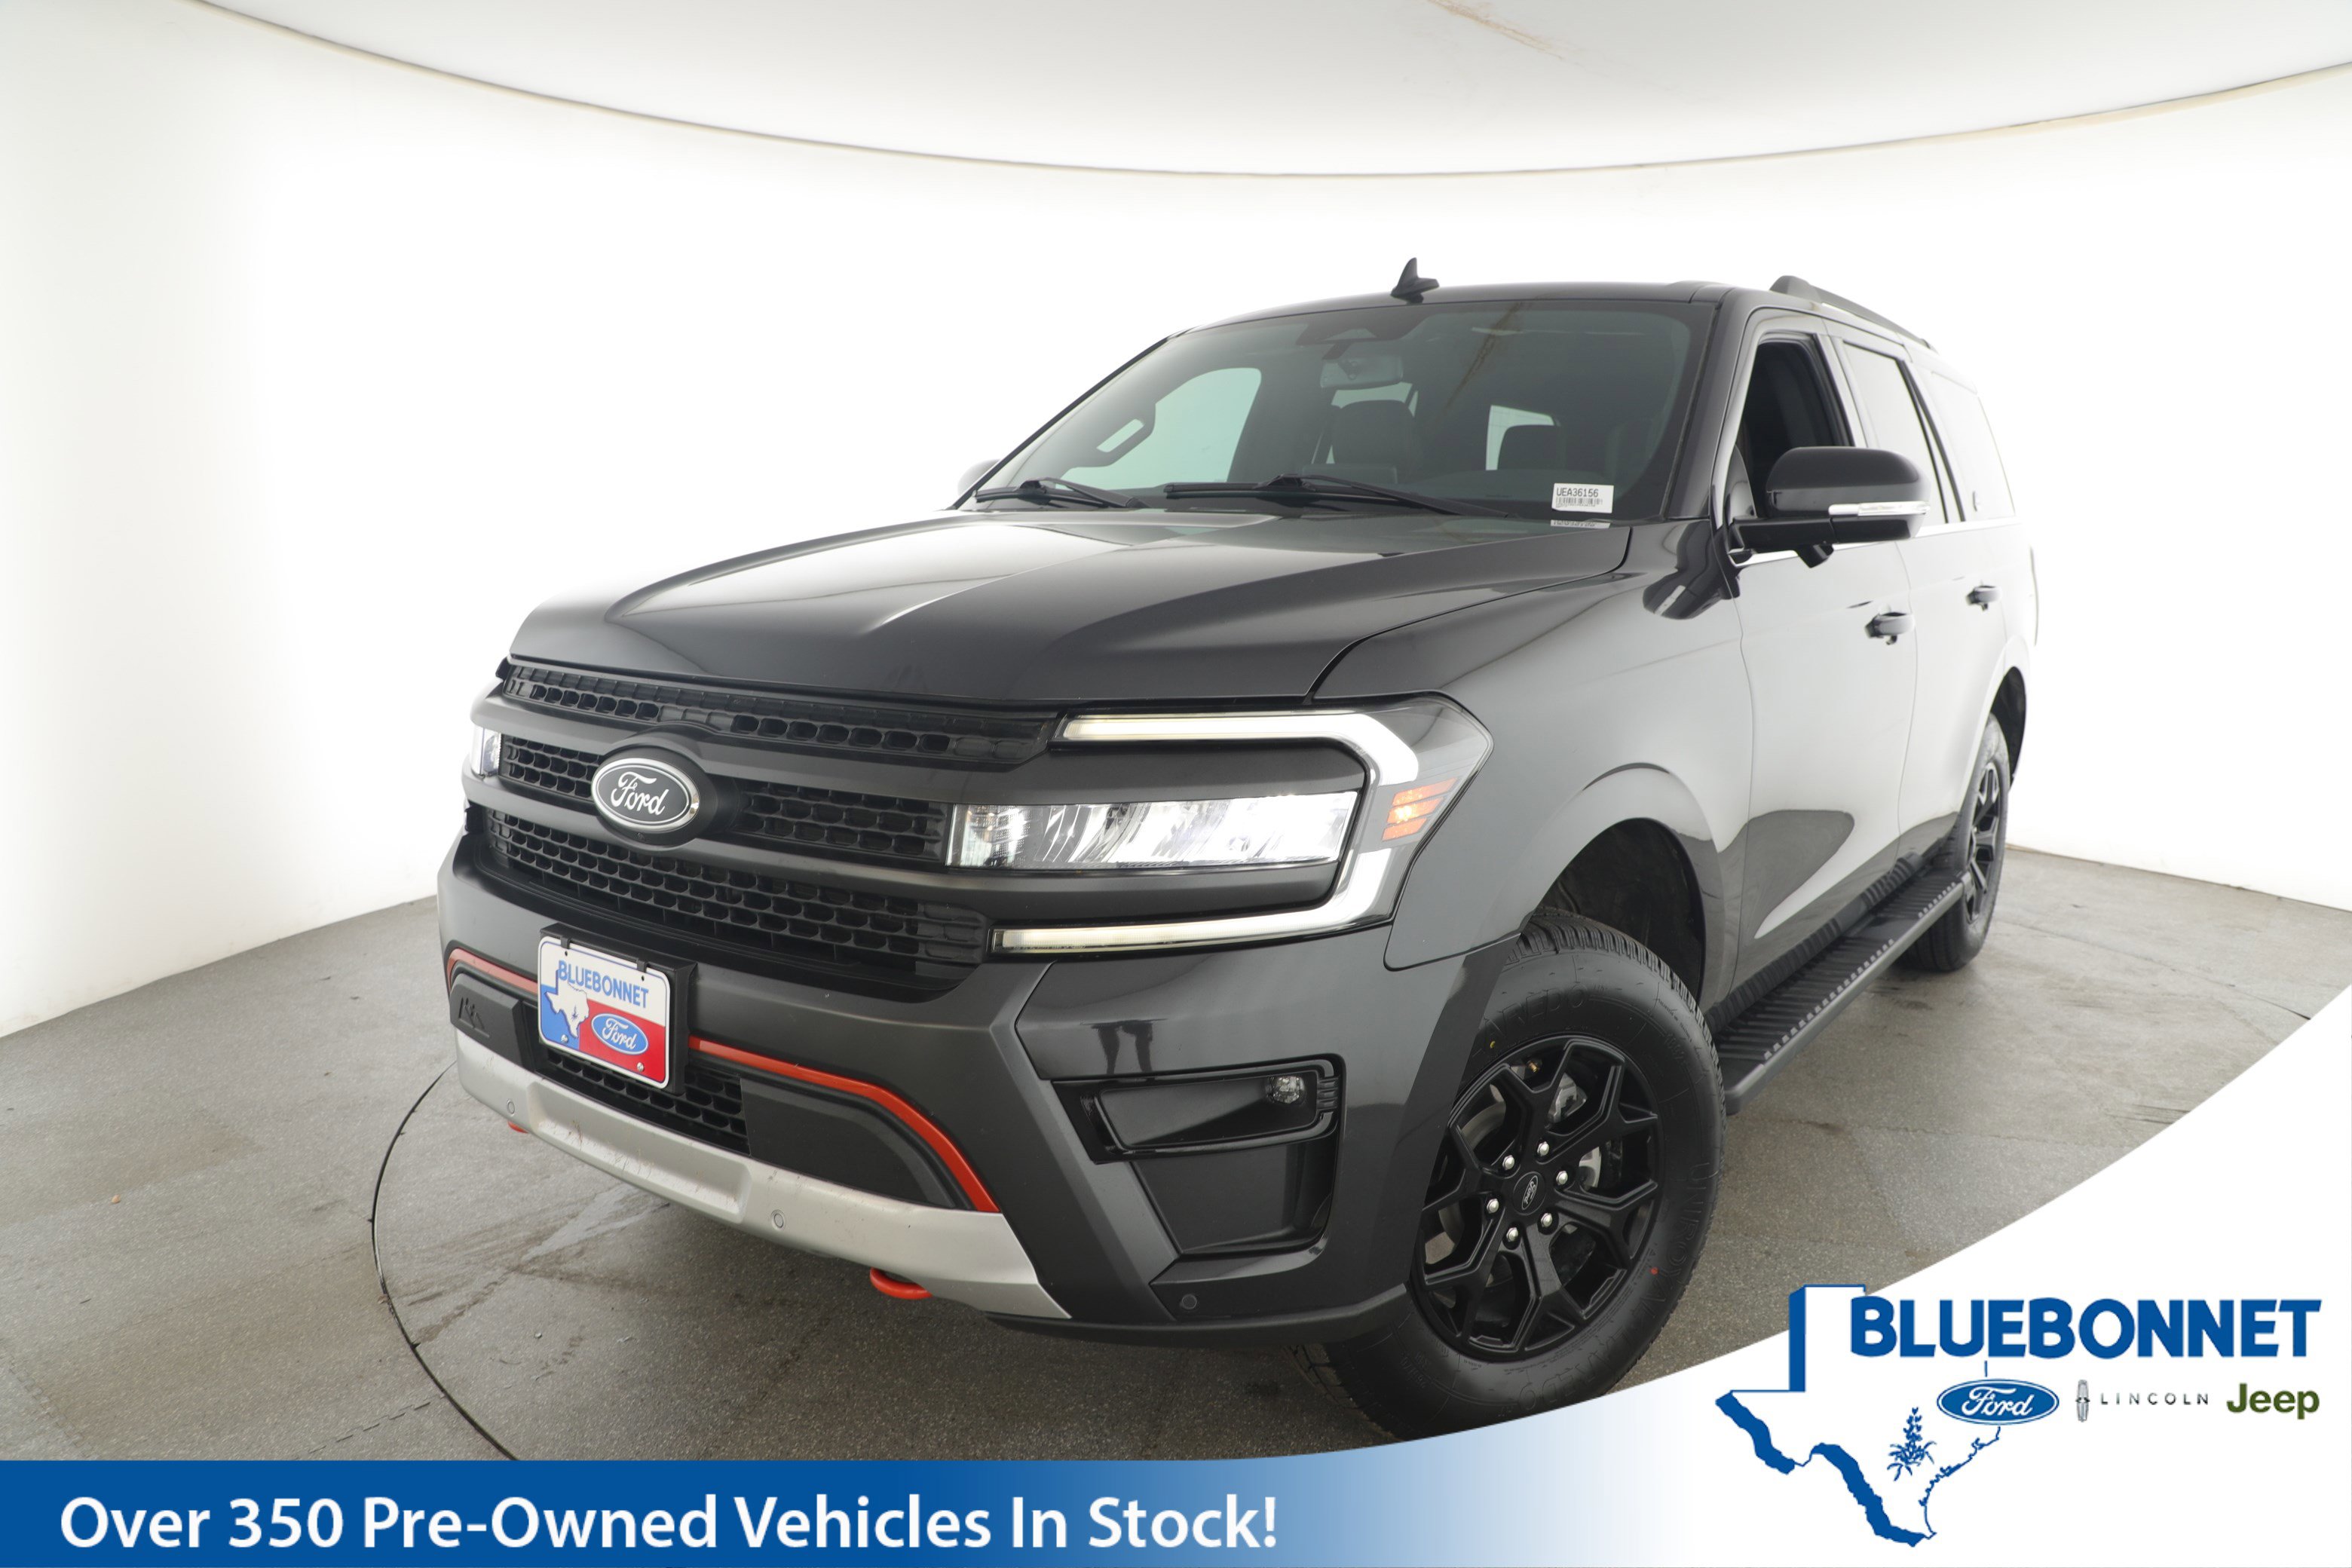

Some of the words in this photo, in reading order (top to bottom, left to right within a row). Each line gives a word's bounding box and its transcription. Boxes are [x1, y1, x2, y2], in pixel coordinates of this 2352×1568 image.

[1556, 487, 1599, 498] UEA36156
[611, 771, 669, 816] Ford
[559, 960, 650, 1009] BLUEBONNET
[602, 1018, 638, 1049] Ford
